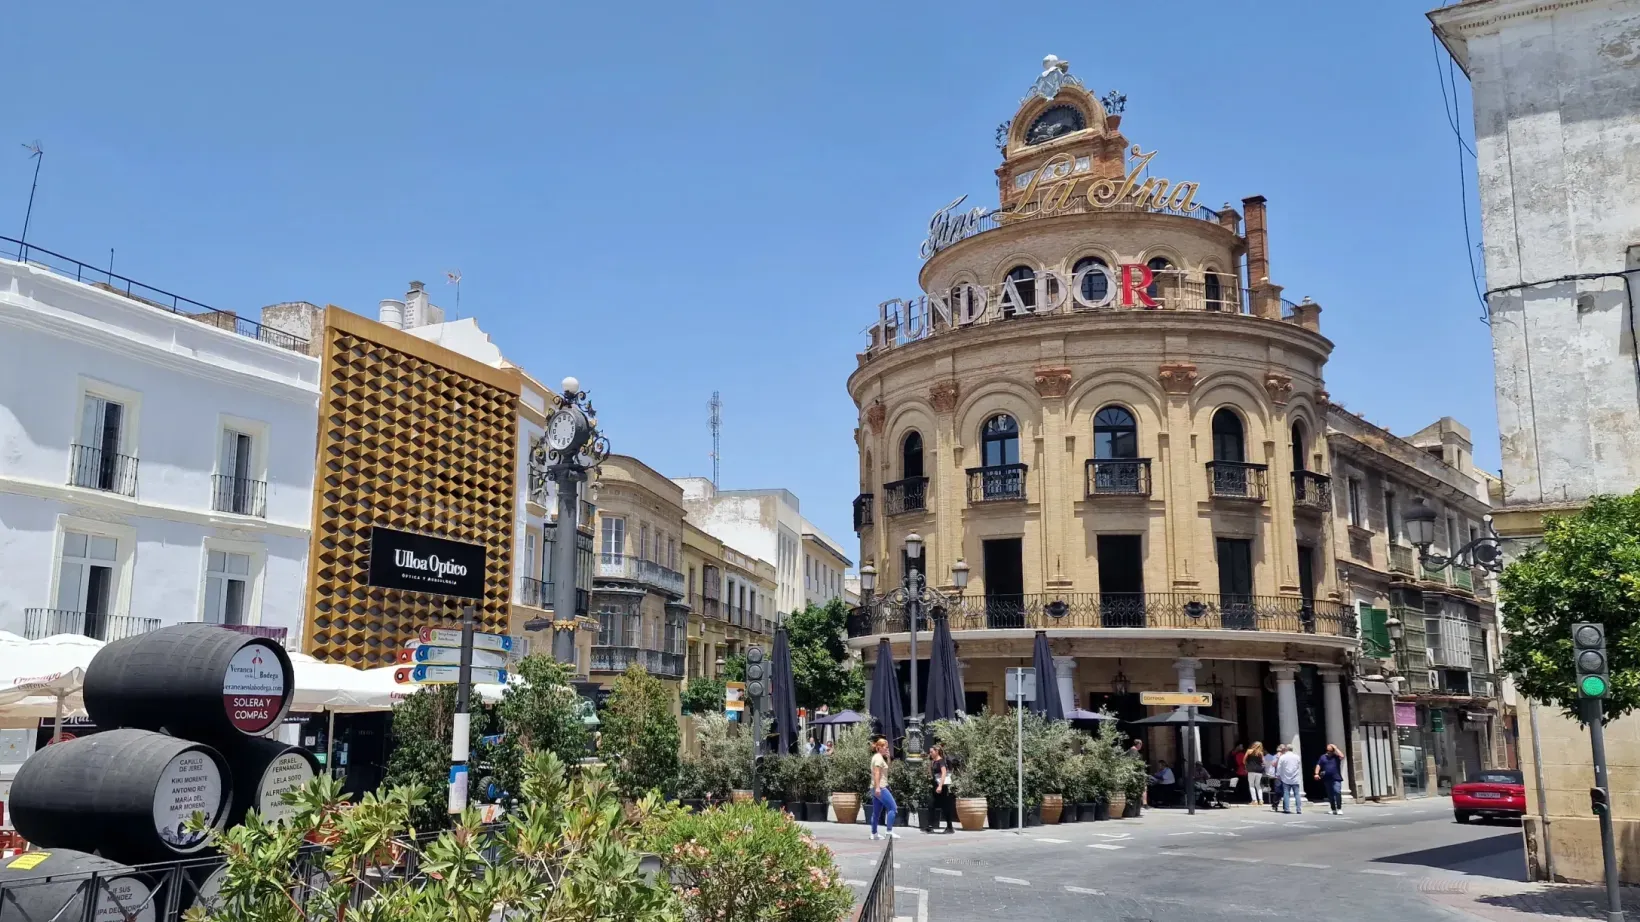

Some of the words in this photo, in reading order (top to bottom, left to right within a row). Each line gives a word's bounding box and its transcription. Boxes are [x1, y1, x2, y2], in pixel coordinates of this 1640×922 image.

[991, 152, 1081, 222] La
[878, 263, 1162, 350] FUNDADOR
[394, 548, 428, 571] Ulloa
[428, 554, 468, 578] Optico
[259, 671, 279, 680] Bodega
[225, 684, 283, 692] eraneaenlabodega.com
[233, 697, 264, 707] SOLERA
[265, 698, 272, 707] Y
[234, 708, 269, 720] COMPÁS
[279, 758, 297, 766] ISRAEL
[174, 796, 193, 804] MARÍA
[108, 893, 133, 903] MNDEZ
